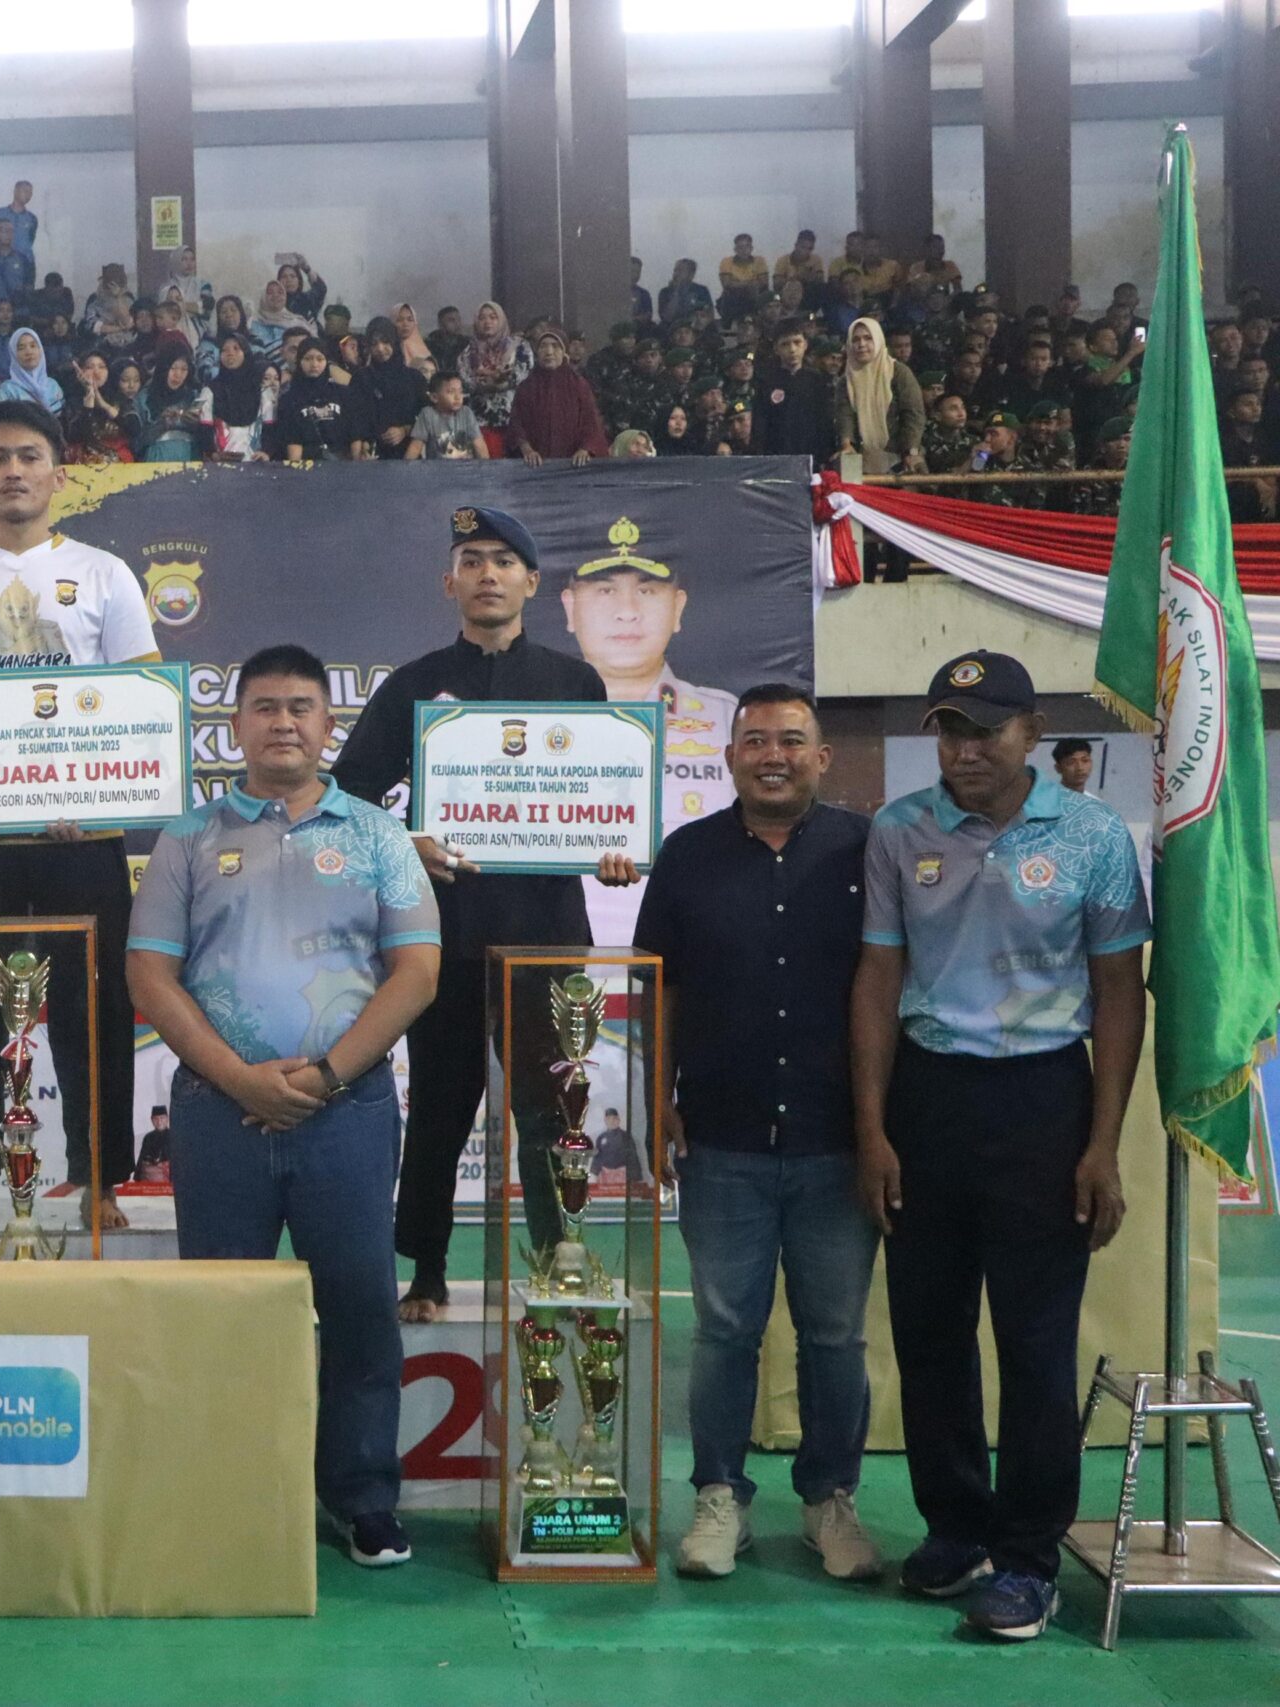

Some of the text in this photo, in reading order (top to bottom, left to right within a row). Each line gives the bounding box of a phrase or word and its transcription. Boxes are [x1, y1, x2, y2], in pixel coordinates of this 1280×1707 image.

[142, 542, 208, 555] BENGKULU
[1187, 629, 1213, 696] SILAT
[14, 728, 44, 740] PENCAK
[47, 726, 66, 738] SILAT
[68, 726, 90, 737] PIALA
[92, 724, 129, 736] KAPOLDA
[131, 722, 173, 734] BENGKULU
[18, 740, 120, 754] SE-SUMATERA TAHUN 2025
[66, 763, 77, 782] I
[85, 760, 160, 781] UMUM
[431, 765, 644, 778] KEJUARAAN PENCAK SILAT PIALA KAPOLDA BENGKULU
[664, 763, 723, 781] POLRI
[484, 781, 589, 794] SE-SUMATERA TAHUN 2025
[25, 790, 97, 808] ASN/TNI/POLRI/
[99, 788, 160, 805] BUMN/BUMD
[439, 803, 635, 824] JUARA II UMUM
[444, 832, 628, 850] KATEGORI ASN/TNI/POLRI/ BUMN/BUMD
[532, 1514, 623, 1526] JUARA UMUM 2
